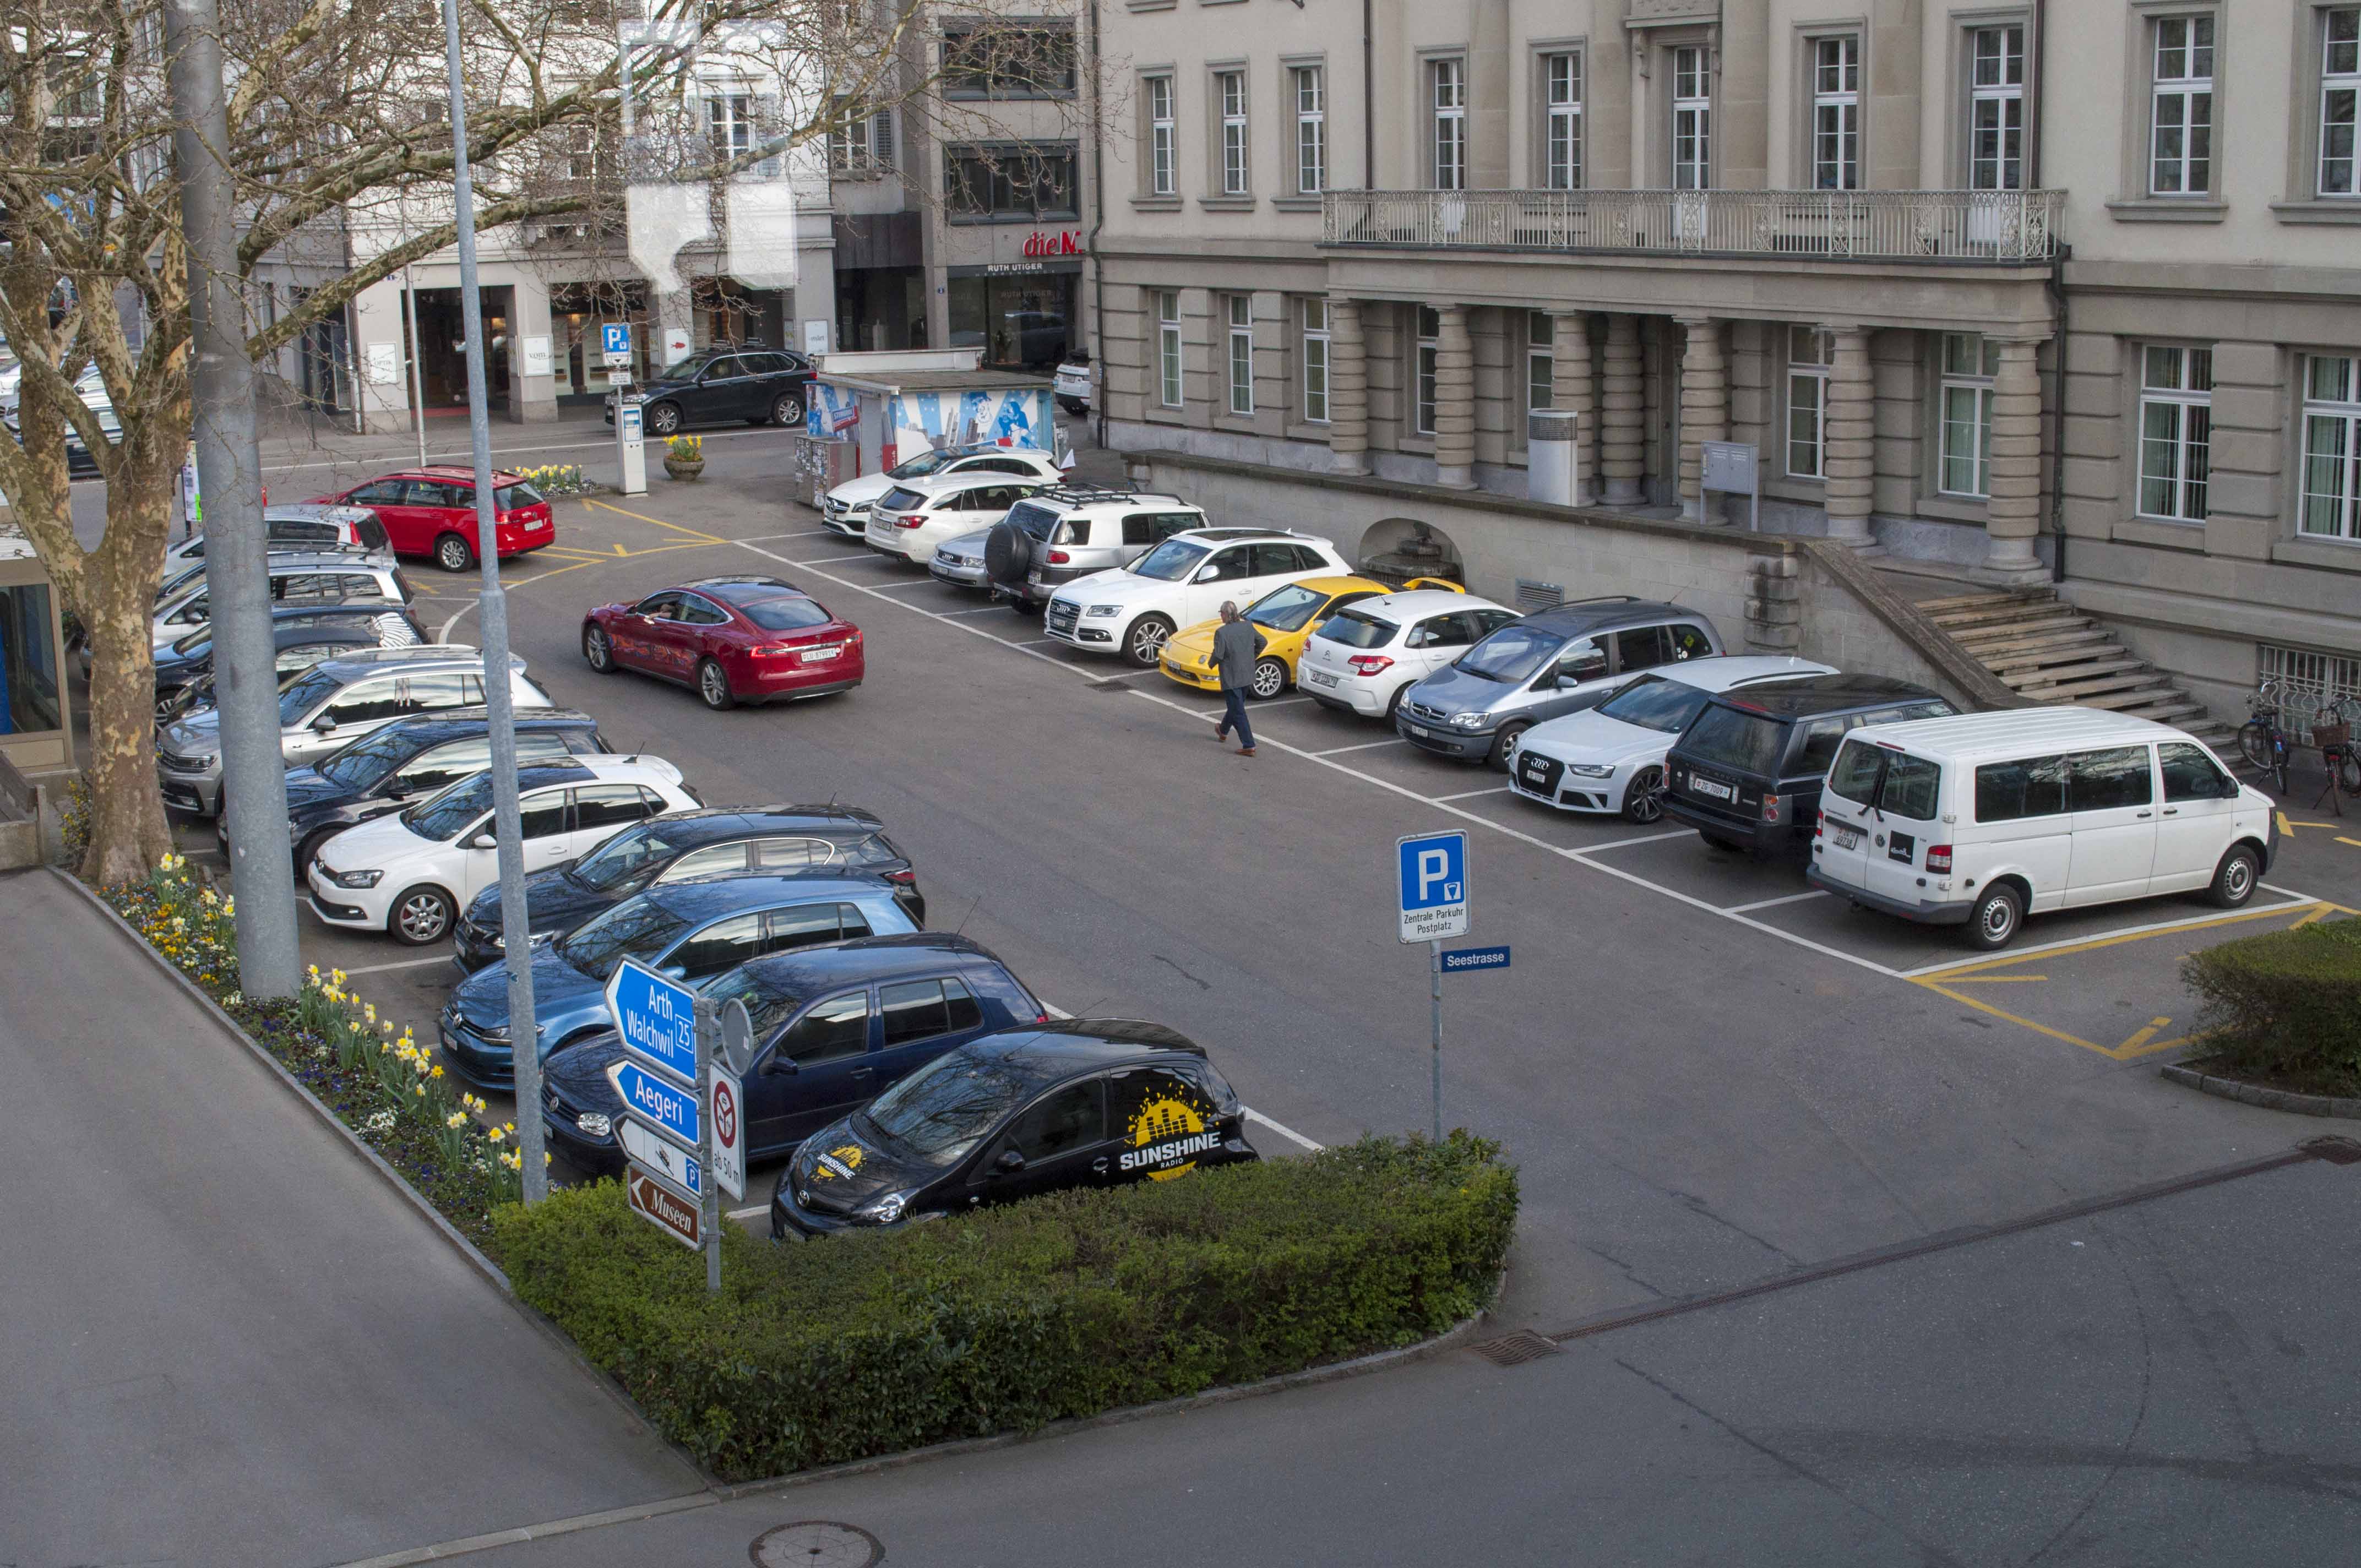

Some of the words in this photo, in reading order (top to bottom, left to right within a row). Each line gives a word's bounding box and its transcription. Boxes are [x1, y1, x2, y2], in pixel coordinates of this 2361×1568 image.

[1022, 231, 1058, 257] die
[1011, 263, 1043, 271] UTIGER
[608, 329, 621, 349] P
[1418, 848, 1449, 901] P
[1404, 911, 1433, 924] Zentrale
[1436, 907, 1464, 919] Parkuhr
[1417, 922, 1452, 934] Postplatz
[1447, 952, 1505, 967] Seestrasse
[648, 984, 673, 1022] Arth
[627, 1008, 674, 1059] Walchwil
[677, 1020, 690, 1047] 25
[635, 1074, 683, 1126] Aegeri
[1119, 1131, 1222, 1170] SUNSHINE
[1160, 1157, 1184, 1169] RADIO
[690, 1168, 695, 1185] P
[714, 1150, 722, 1170] ab
[723, 1156, 732, 1179] 50
[733, 1169, 740, 1186] m
[817, 1153, 856, 1180] SUNSHINE
[650, 1188, 692, 1233] Museen
